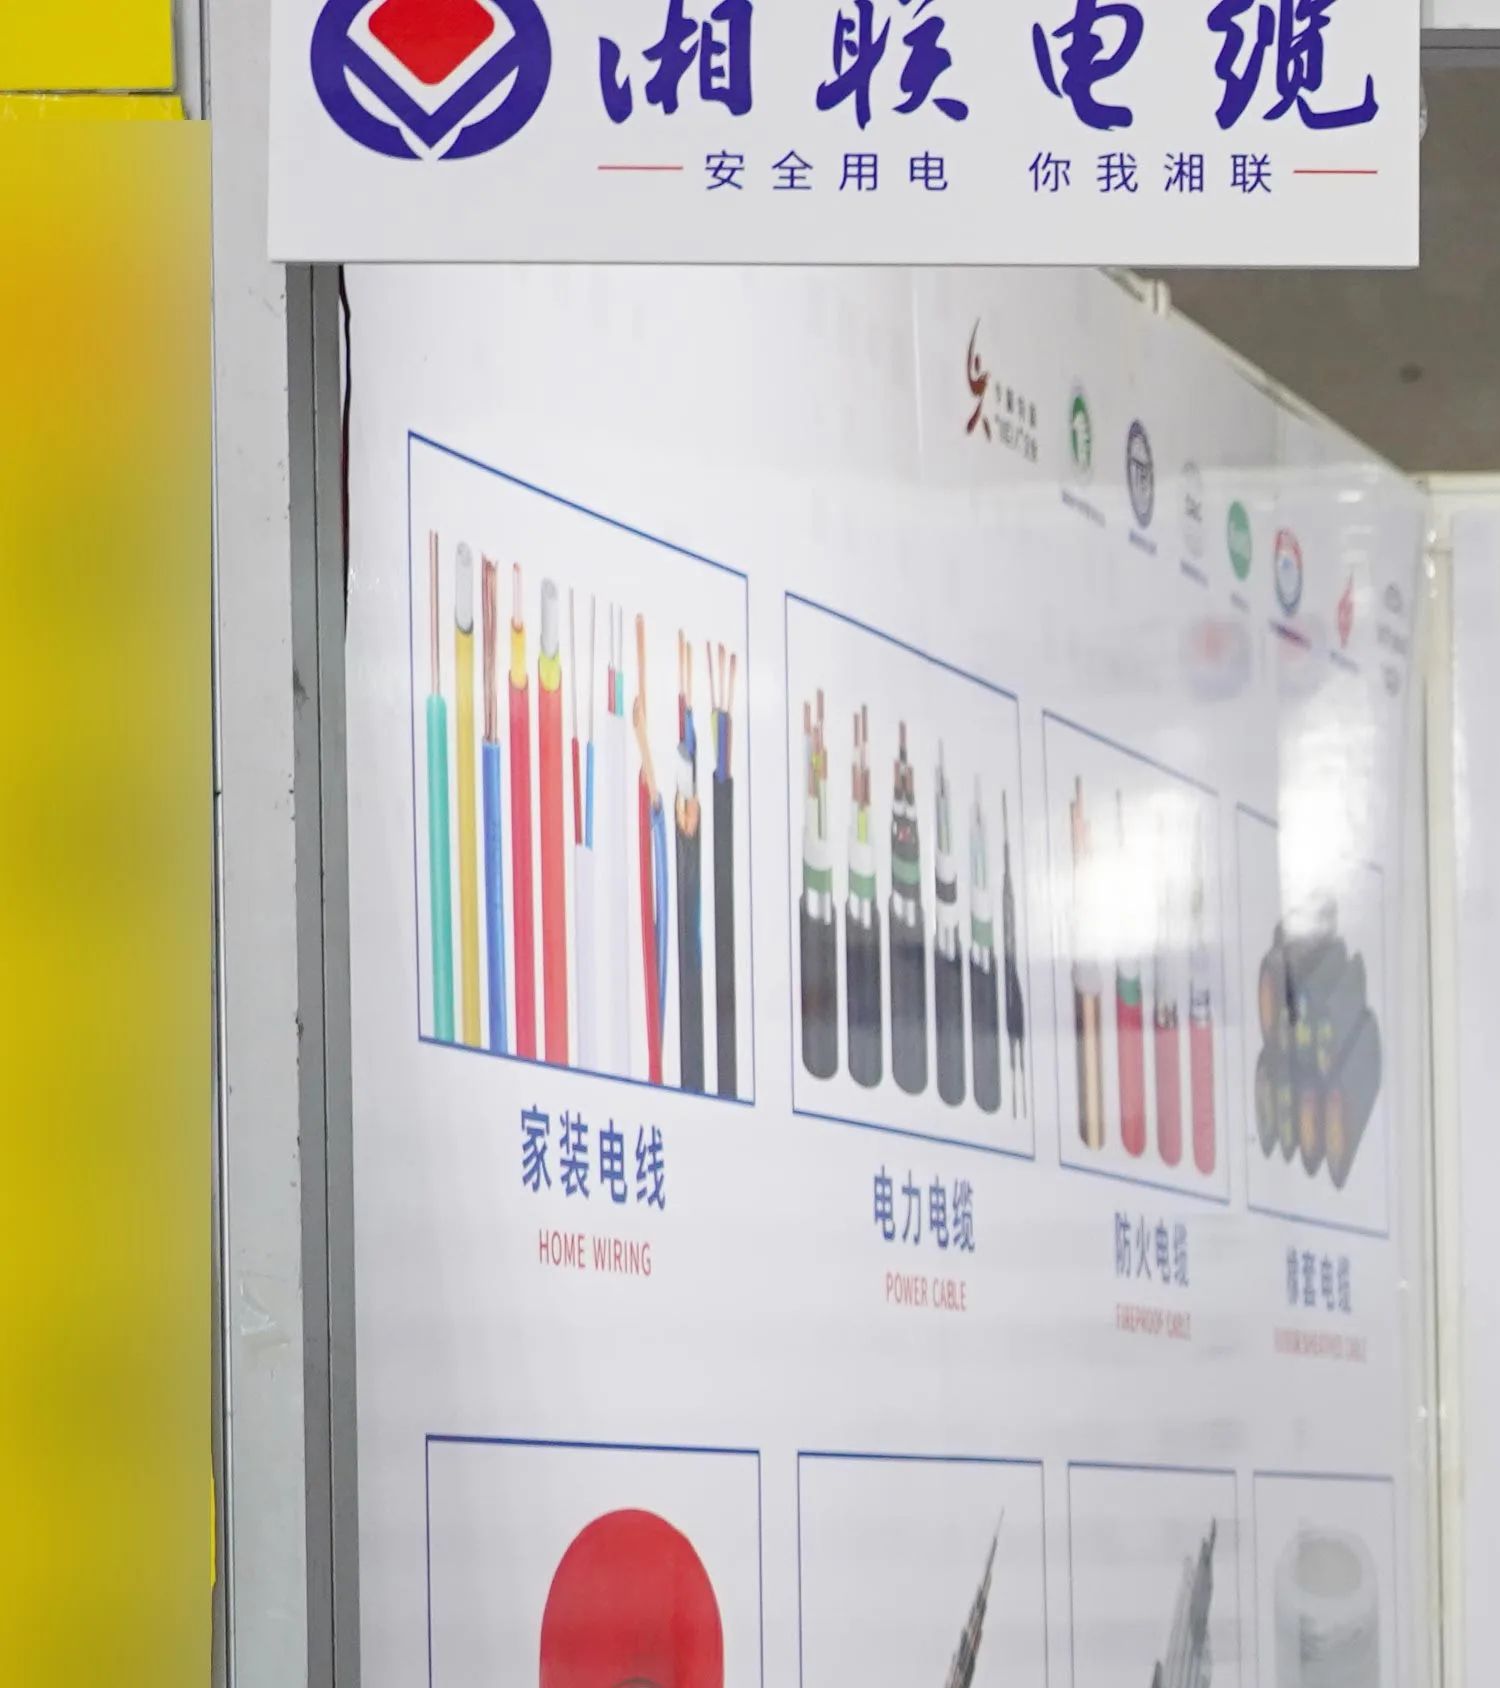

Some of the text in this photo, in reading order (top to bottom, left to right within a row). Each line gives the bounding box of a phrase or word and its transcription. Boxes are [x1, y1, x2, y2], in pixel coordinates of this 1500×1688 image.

[598, 0, 1378, 132] 湘联电缆
[705, 149, 1275, 195] 安全用电 你我湘联
[519, 1103, 667, 1210] 家装电线
[872, 1166, 976, 1255] 电力电缆
[538, 1229, 652, 1276] HOME WIRING
[1114, 1211, 1189, 1288] 防火电缆
[885, 1272, 967, 1313] POWER CABLE
